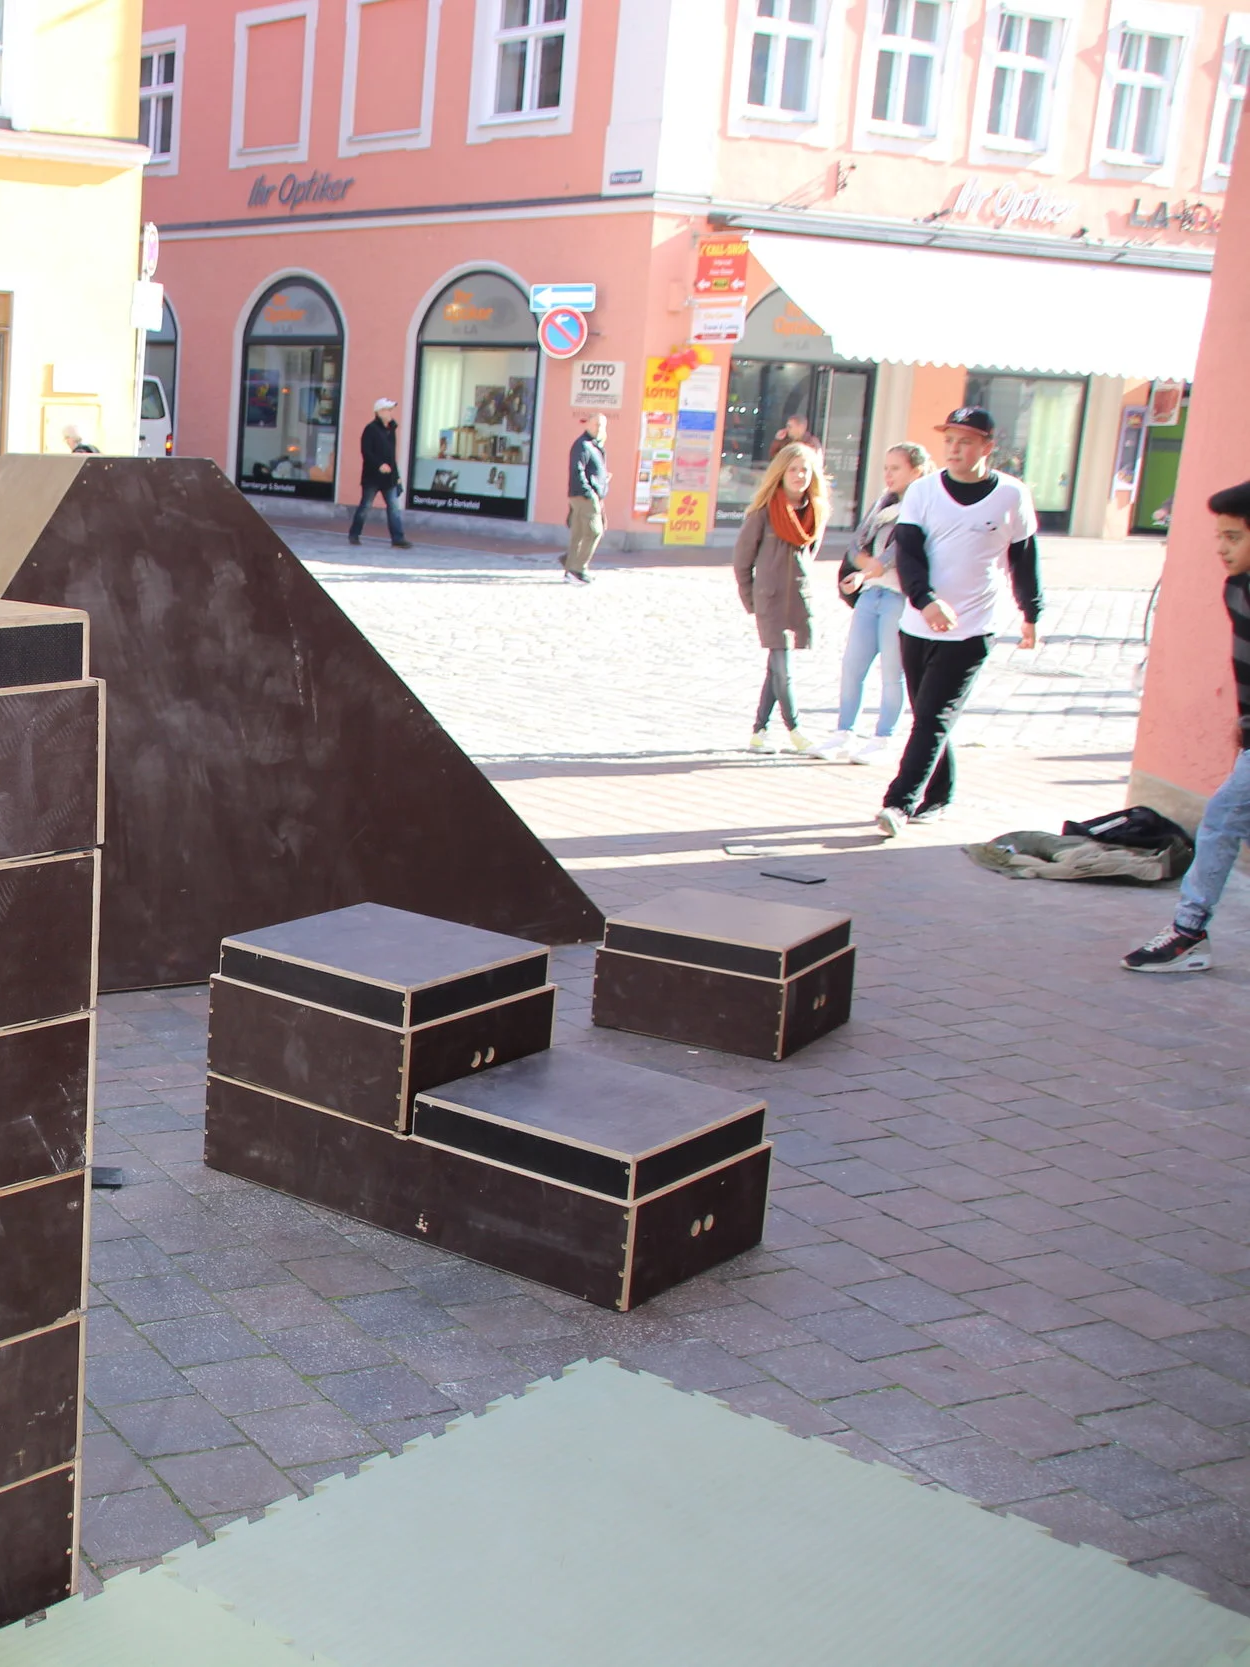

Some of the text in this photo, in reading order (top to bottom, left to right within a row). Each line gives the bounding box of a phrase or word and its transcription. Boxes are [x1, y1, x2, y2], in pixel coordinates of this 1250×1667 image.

[247, 168, 355, 211] Ihr Optiker
[953, 175, 1080, 225] Ihr Optiker
[581, 362, 616, 377] LOTTO
[580, 377, 611, 392] TOTO
[645, 386, 678, 399] LOTTO
[669, 519, 701, 532] LOTTO
